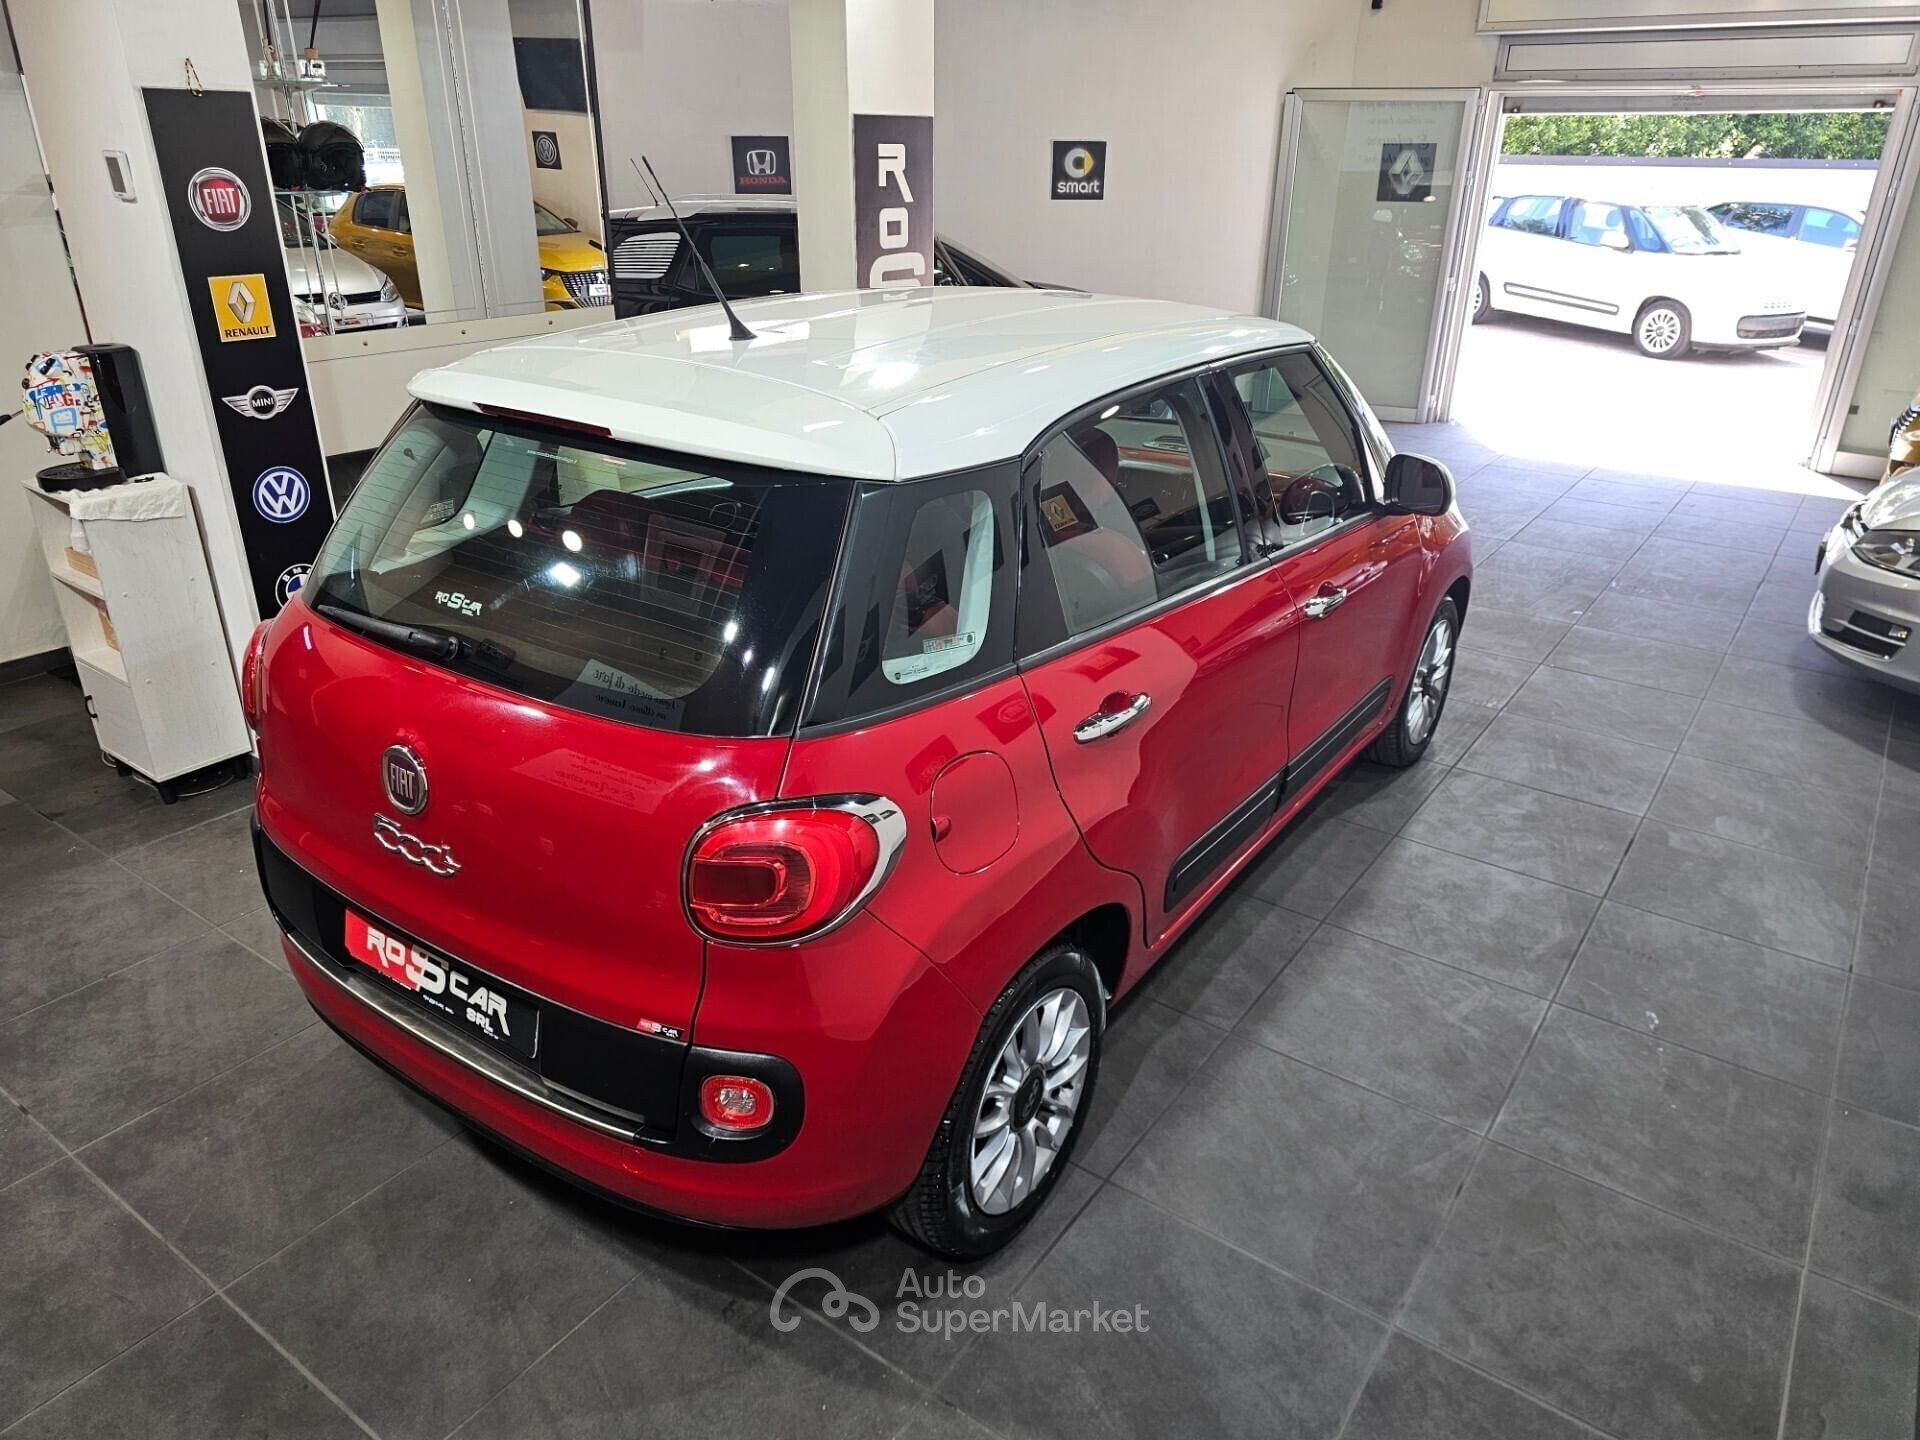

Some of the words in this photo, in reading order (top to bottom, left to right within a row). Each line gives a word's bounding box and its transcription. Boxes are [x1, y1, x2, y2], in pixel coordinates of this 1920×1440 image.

[739, 176, 785, 185] HONDA
[1057, 180, 1100, 193] smart
[202, 188, 236, 214] FIAT
[225, 326, 270, 338] RENAULT
[252, 398, 274, 408] MINI
[390, 763, 415, 799] FIAT
[466, 1007, 494, 1034] SRL
